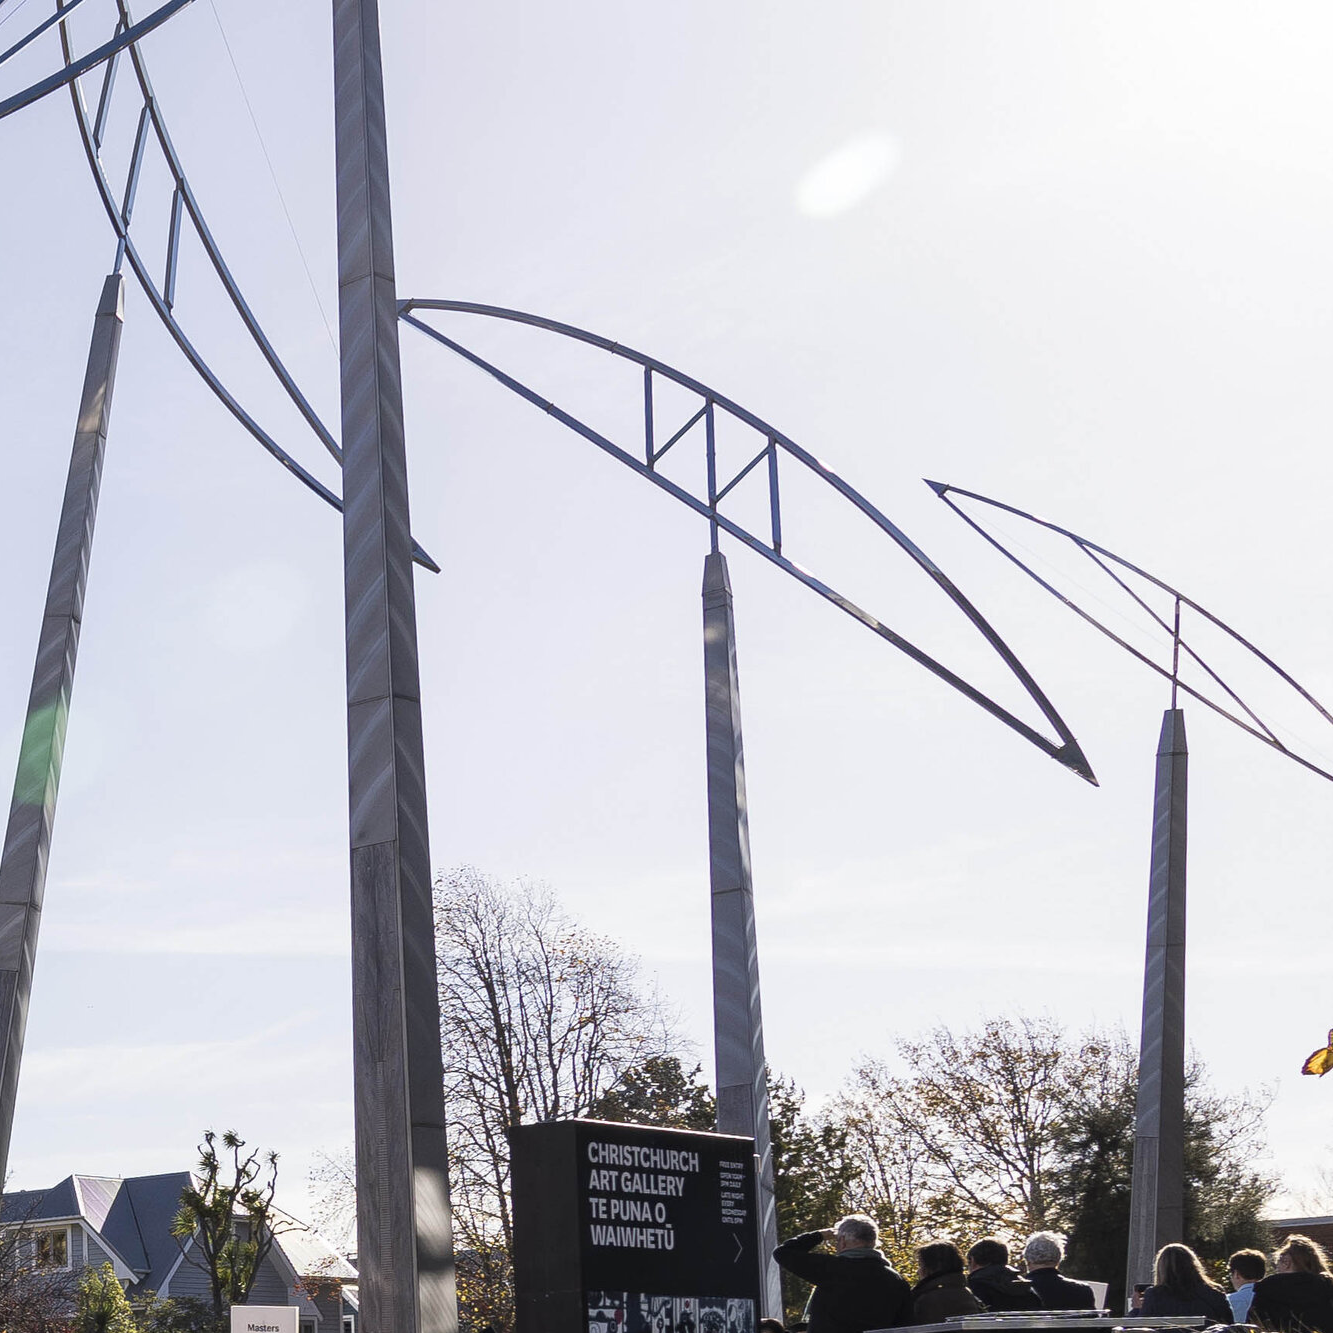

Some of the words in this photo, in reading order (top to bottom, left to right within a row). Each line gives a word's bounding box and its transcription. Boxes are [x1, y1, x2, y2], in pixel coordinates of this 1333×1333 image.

[588, 1142, 699, 1172] CHRISTCHURCH
[589, 1169, 619, 1191] ART
[621, 1172, 684, 1196] GALLERY
[589, 1198, 607, 1218] TE
[611, 1199, 652, 1222] PUNA
[655, 1202, 666, 1223] O
[590, 1223, 674, 1250] WAIWHETŪ
[247, 1323, 280, 1332] Masters
